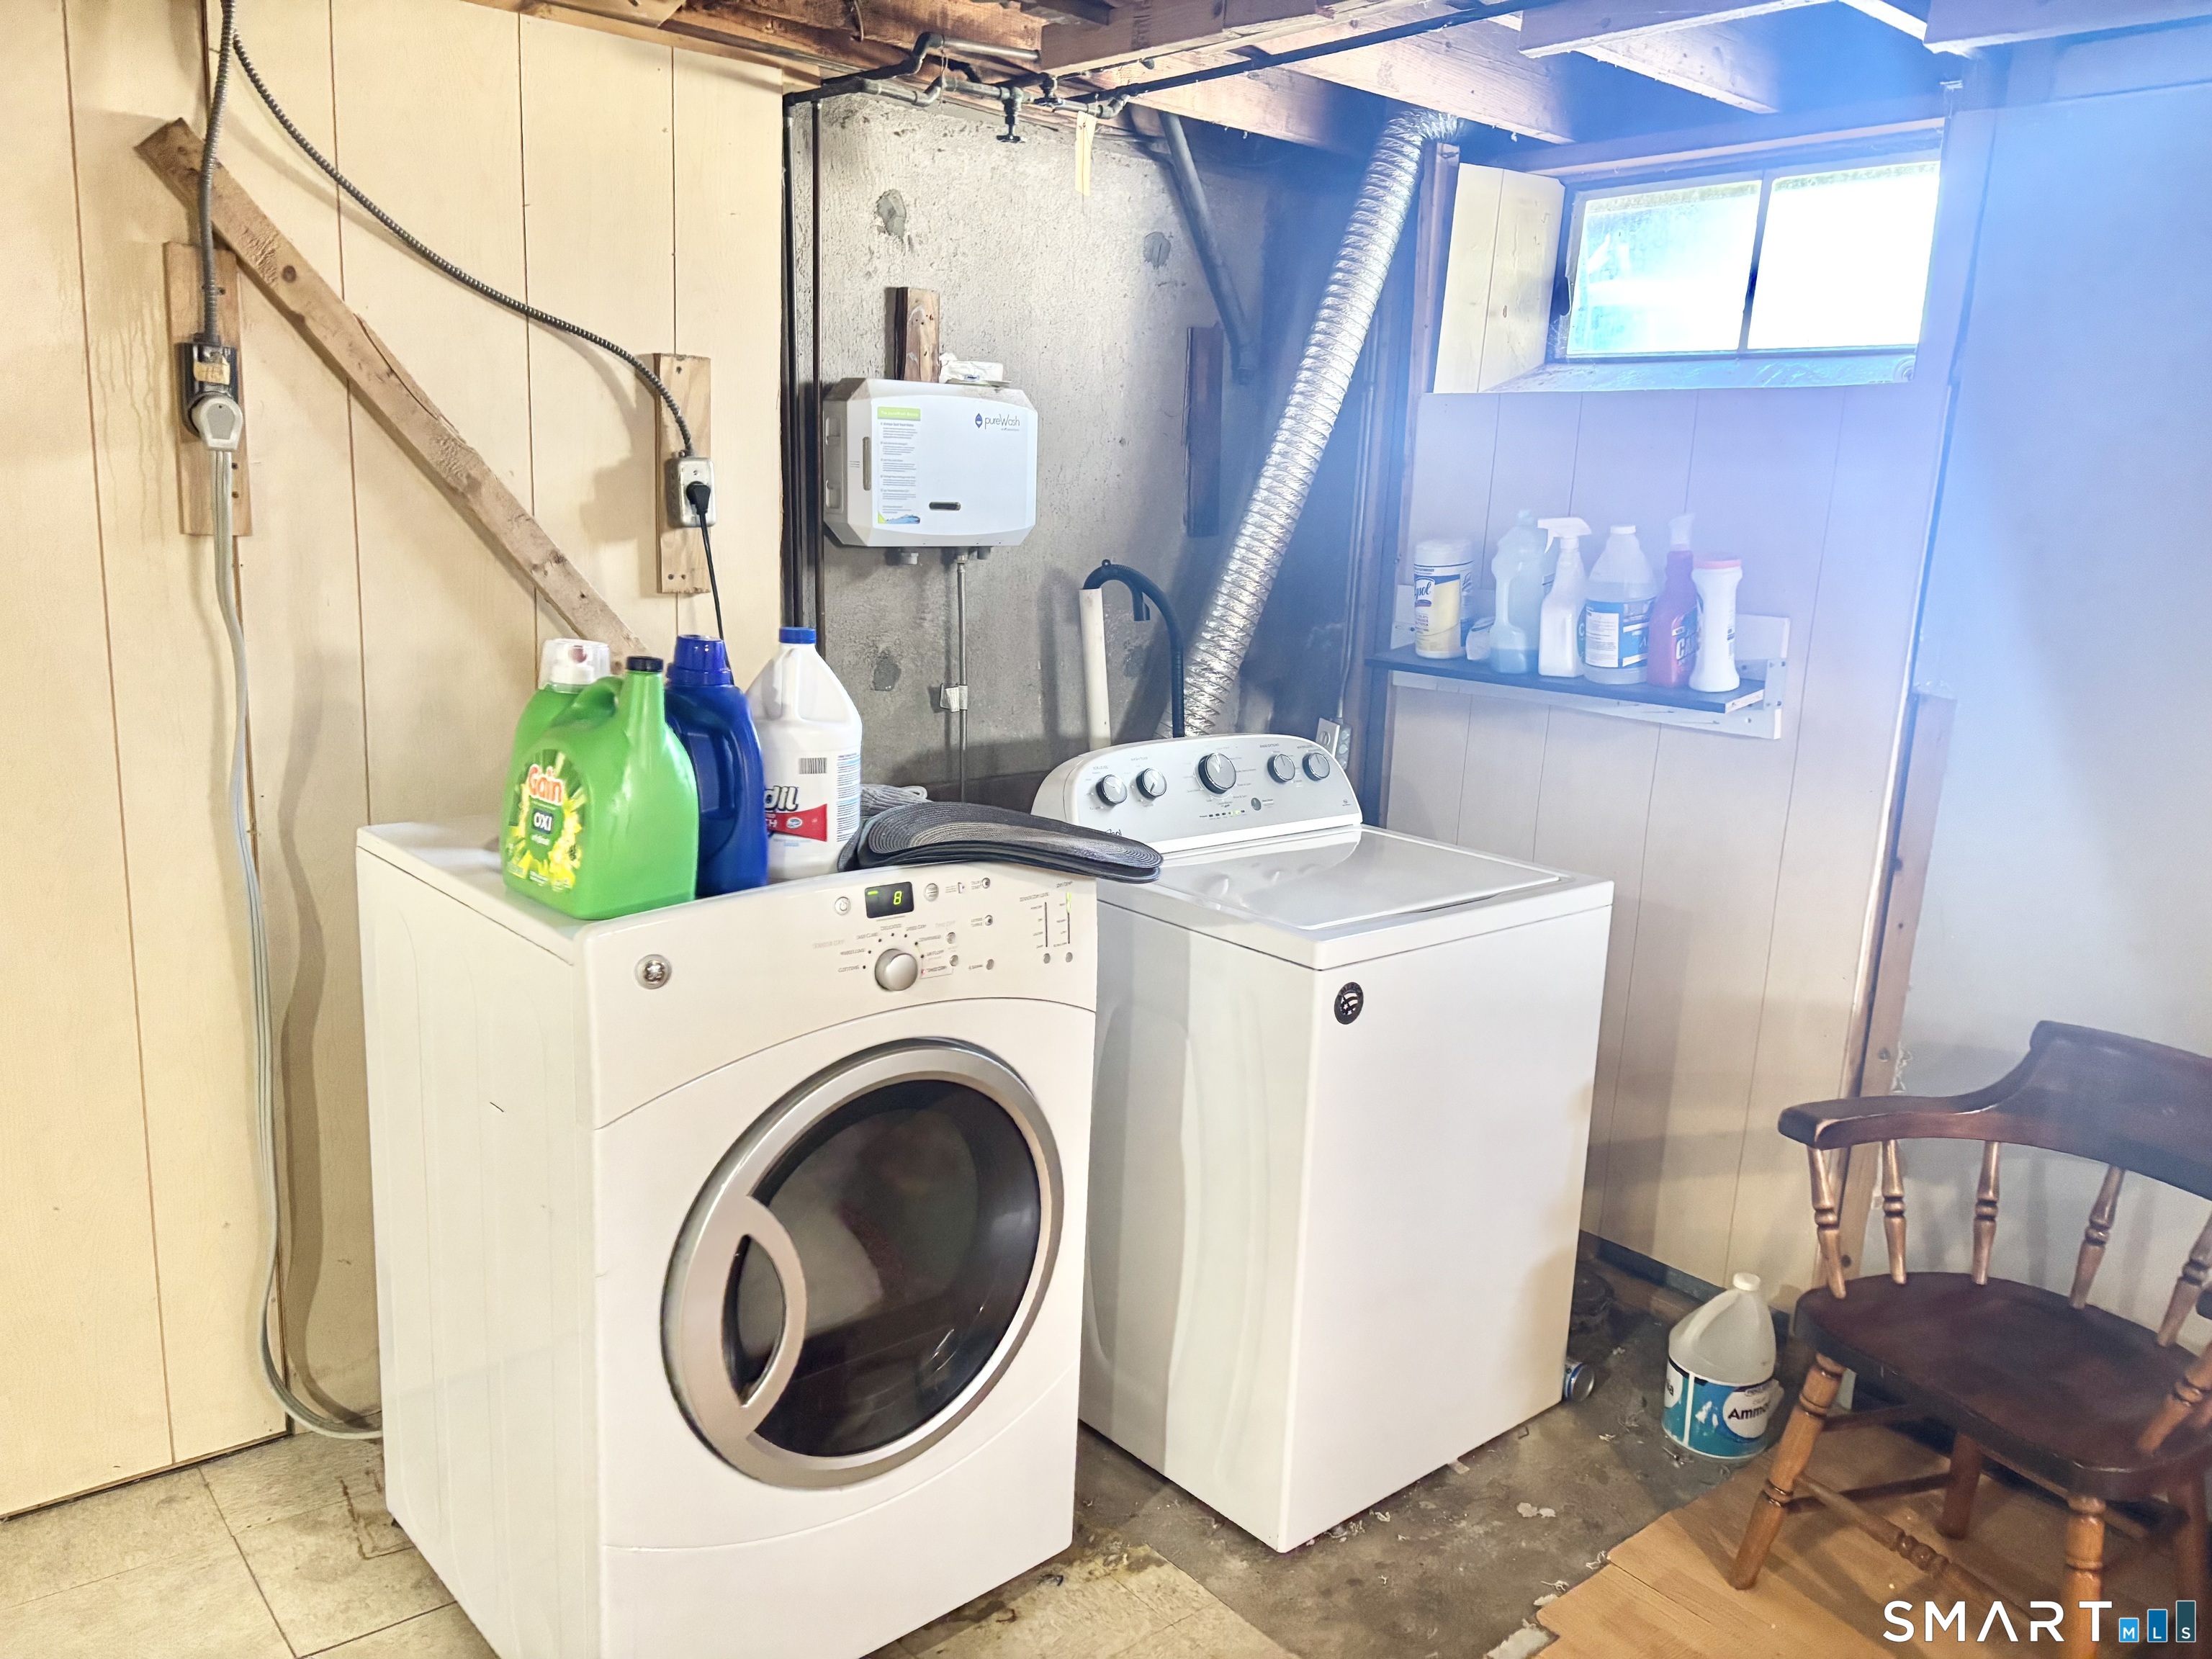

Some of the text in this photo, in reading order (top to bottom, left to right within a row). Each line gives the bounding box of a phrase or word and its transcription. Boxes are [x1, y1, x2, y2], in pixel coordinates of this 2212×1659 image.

[984, 413, 1020, 430] pureWash
[1413, 581, 1432, 601] ysol
[528, 763, 564, 806] Gain
[534, 811, 552, 832] OXI
[893, 891, 902, 905] 8
